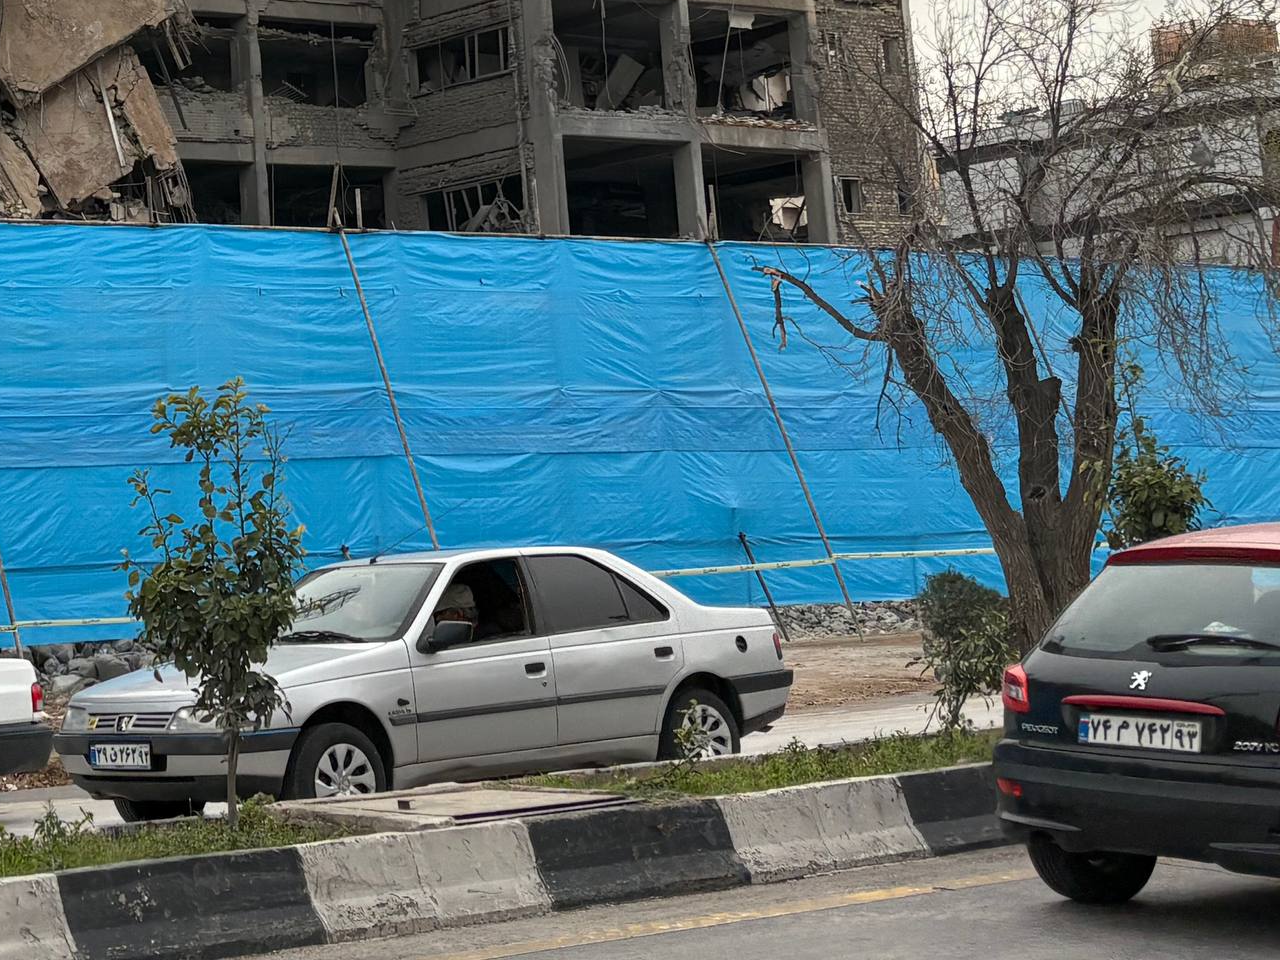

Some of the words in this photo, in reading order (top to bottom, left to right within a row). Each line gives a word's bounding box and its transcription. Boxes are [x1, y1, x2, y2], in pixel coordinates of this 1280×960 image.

[1090, 719, 1112, 741] ۷۴
[1117, 720, 1130, 742] م
[1135, 721, 1171, 746] ۷۴۲
[1175, 728, 1198, 749] ۹۳
